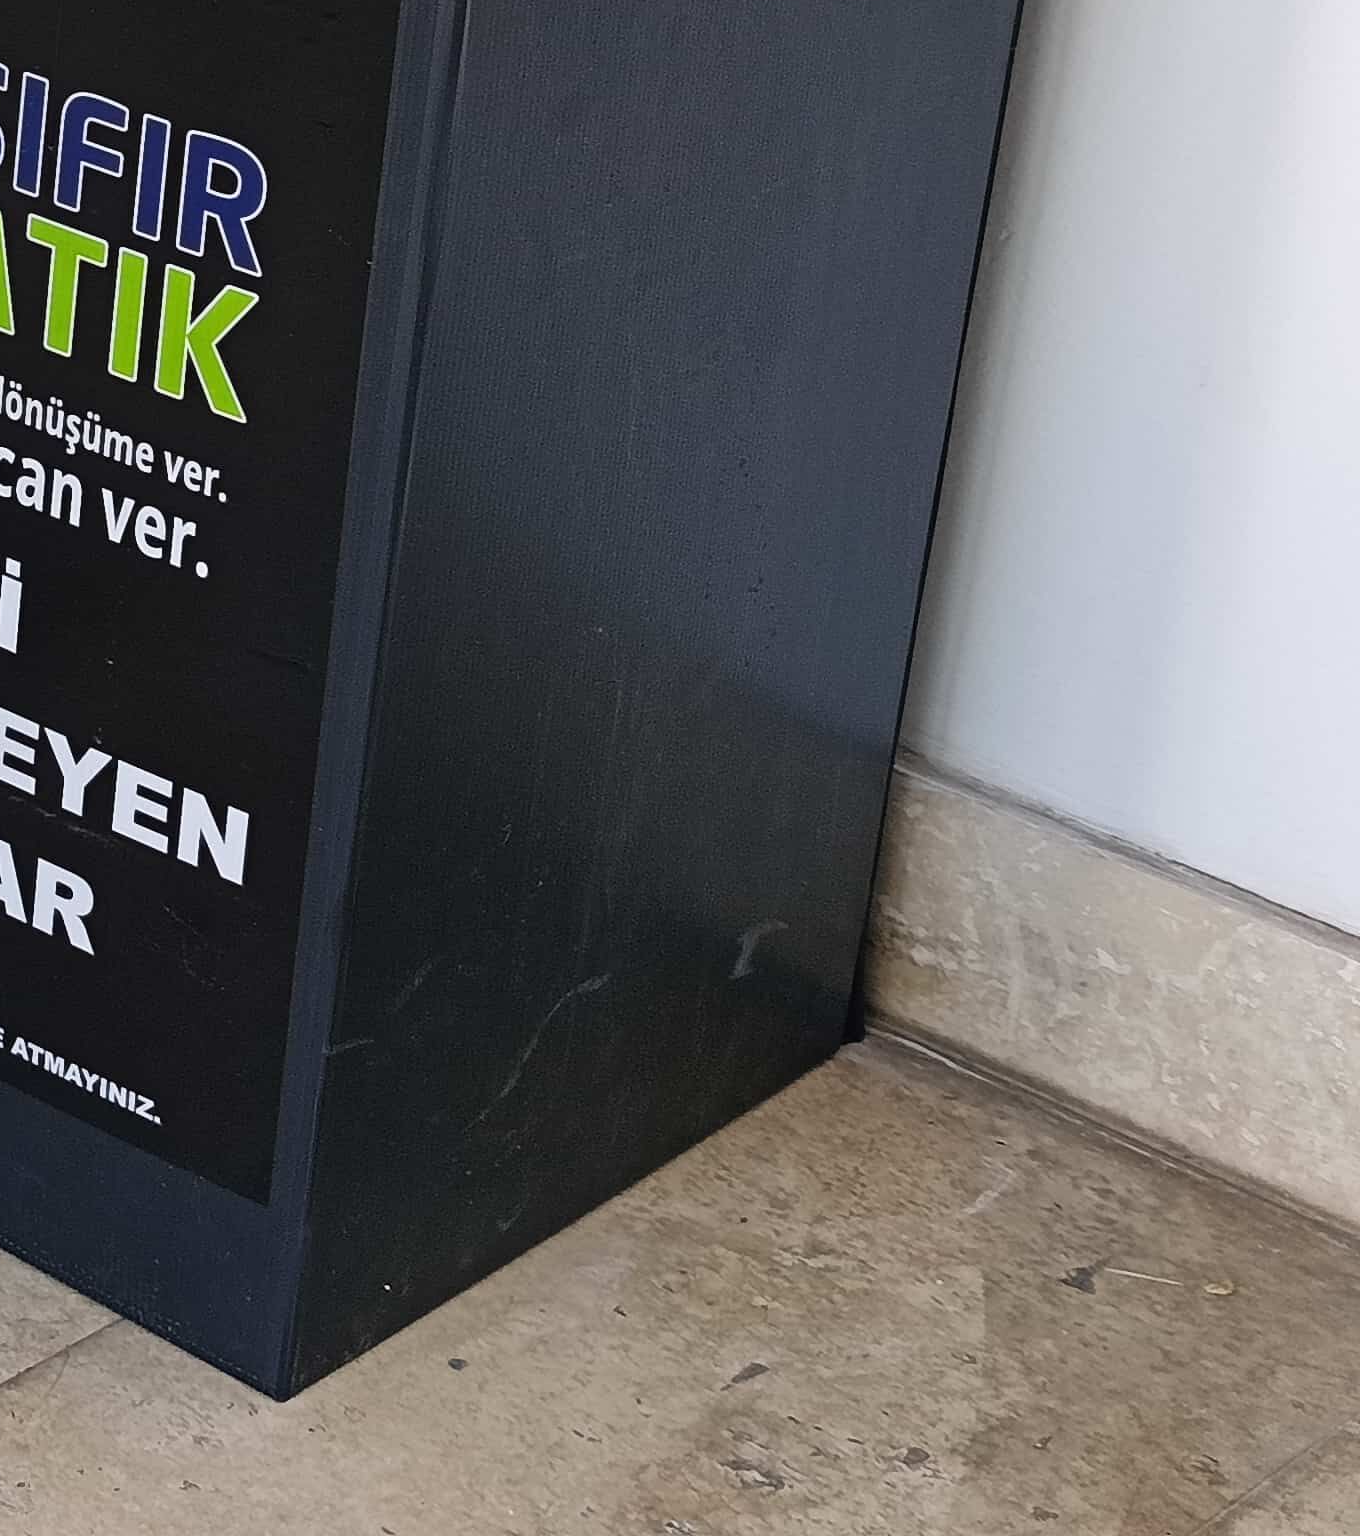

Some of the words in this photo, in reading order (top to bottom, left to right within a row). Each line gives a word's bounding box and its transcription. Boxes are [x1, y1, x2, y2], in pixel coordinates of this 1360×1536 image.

[163, 450, 229, 503] ver.
[101, 485, 208, 578] ver.
[11, 1037, 163, 1126] ATMAYINIZ.
